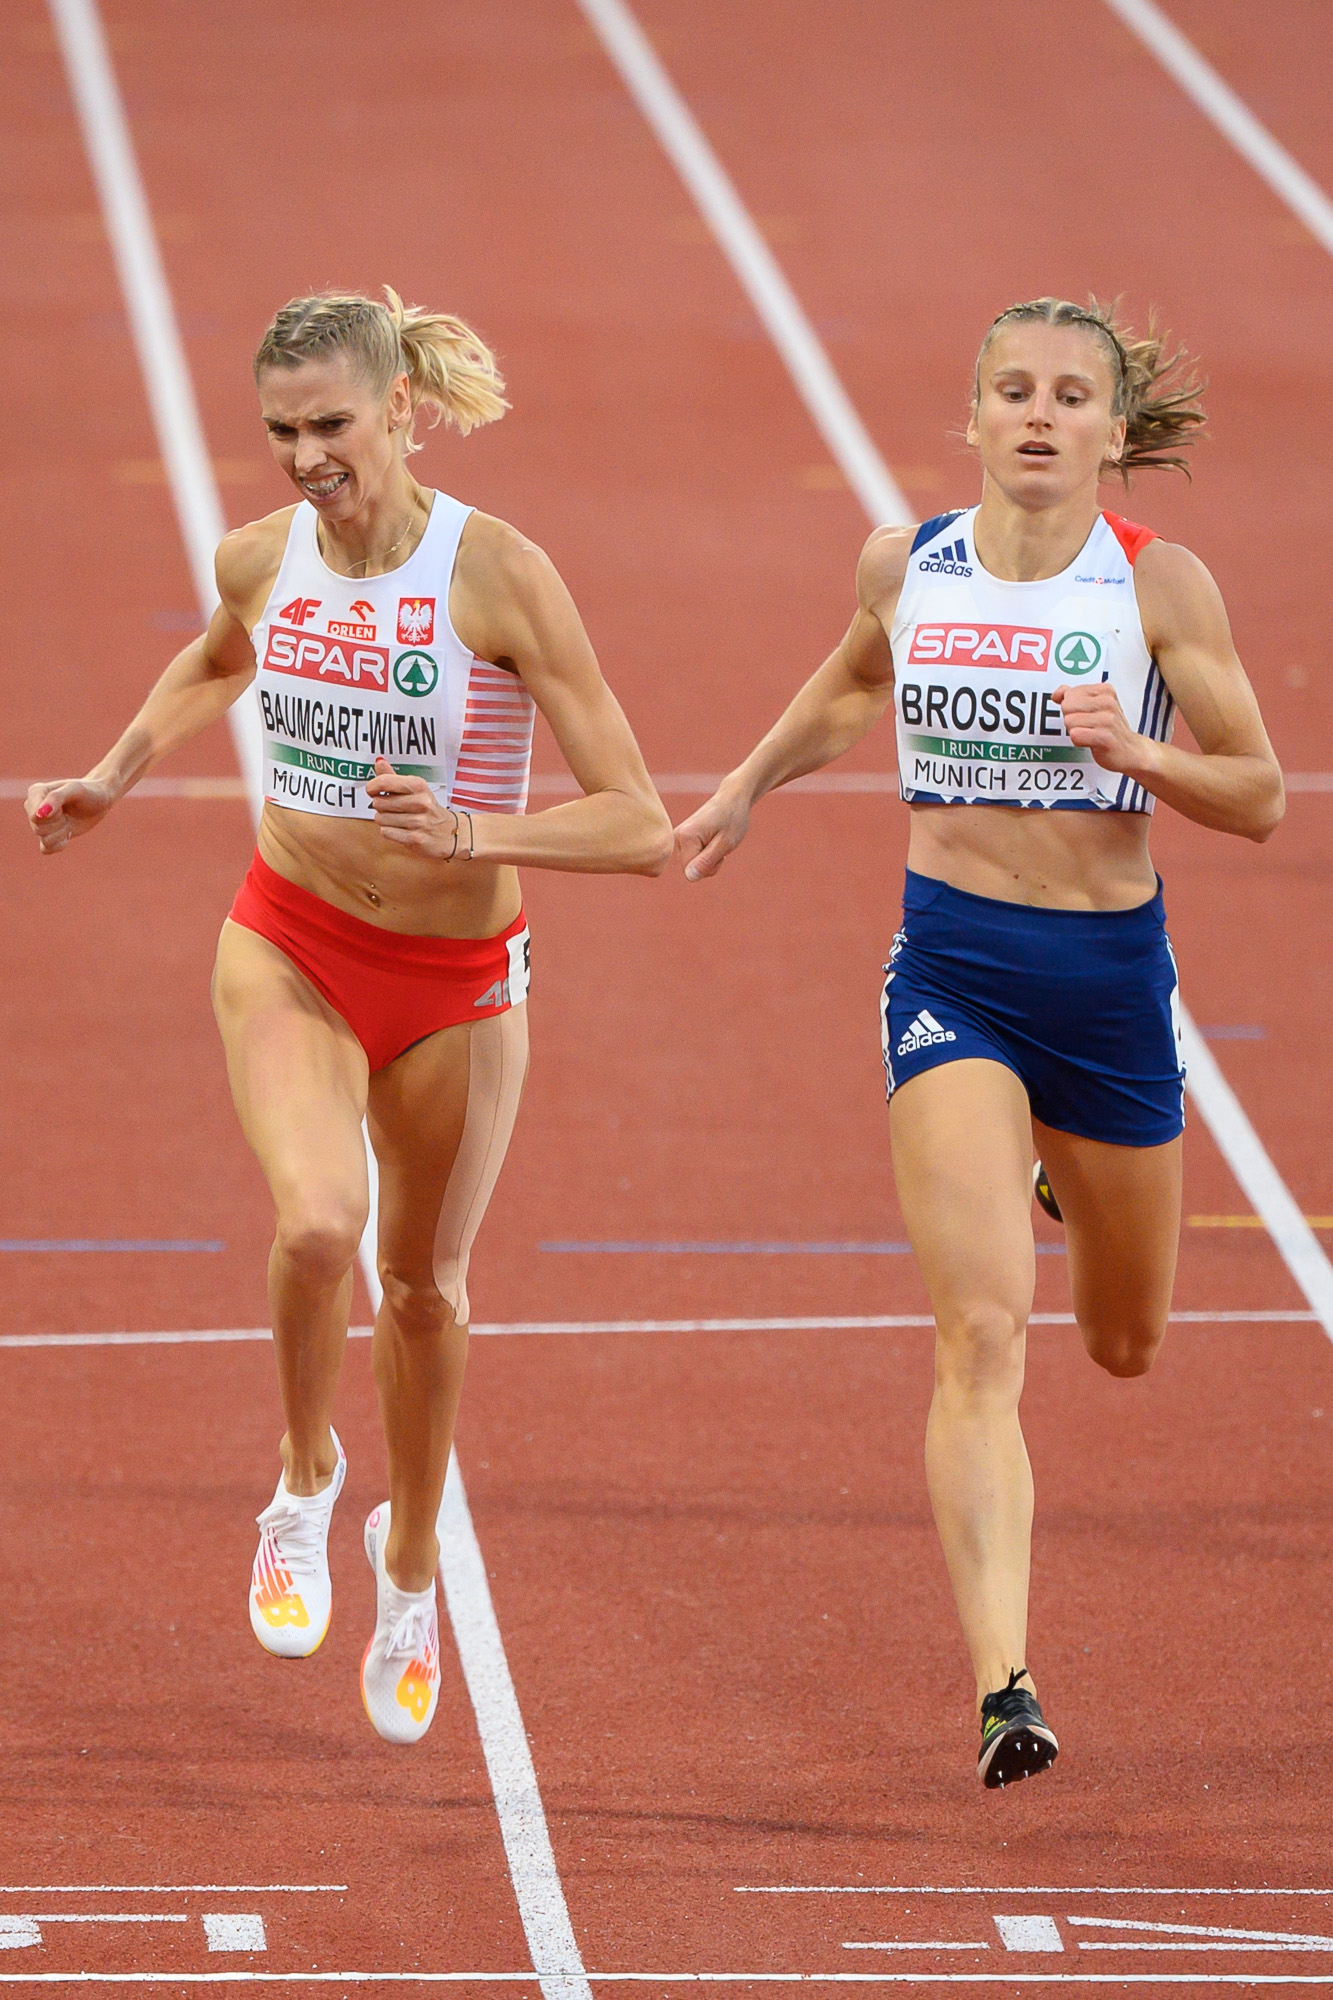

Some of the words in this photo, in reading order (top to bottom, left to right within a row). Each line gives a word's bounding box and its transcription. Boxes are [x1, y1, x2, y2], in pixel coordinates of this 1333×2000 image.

[918, 558, 973, 578] adidas
[279, 597, 322, 626] 4F
[330, 623, 374, 639] ORLEN
[268, 632, 386, 686] SPAR
[913, 628, 1047, 666] SPAR
[260, 690, 437, 756] BAUMGART-WITAN
[902, 684, 1069, 737] BROSSIE
[300, 751, 304, 766] I
[307, 754, 336, 772] RUN
[941, 740, 946, 752] I
[951, 741, 984, 757] RUN
[273, 767, 356, 808] MUNICH
[914, 759, 1006, 791] MUNICH
[1017, 769, 1085, 791] 2022
[897, 1031, 957, 1056] adidas
